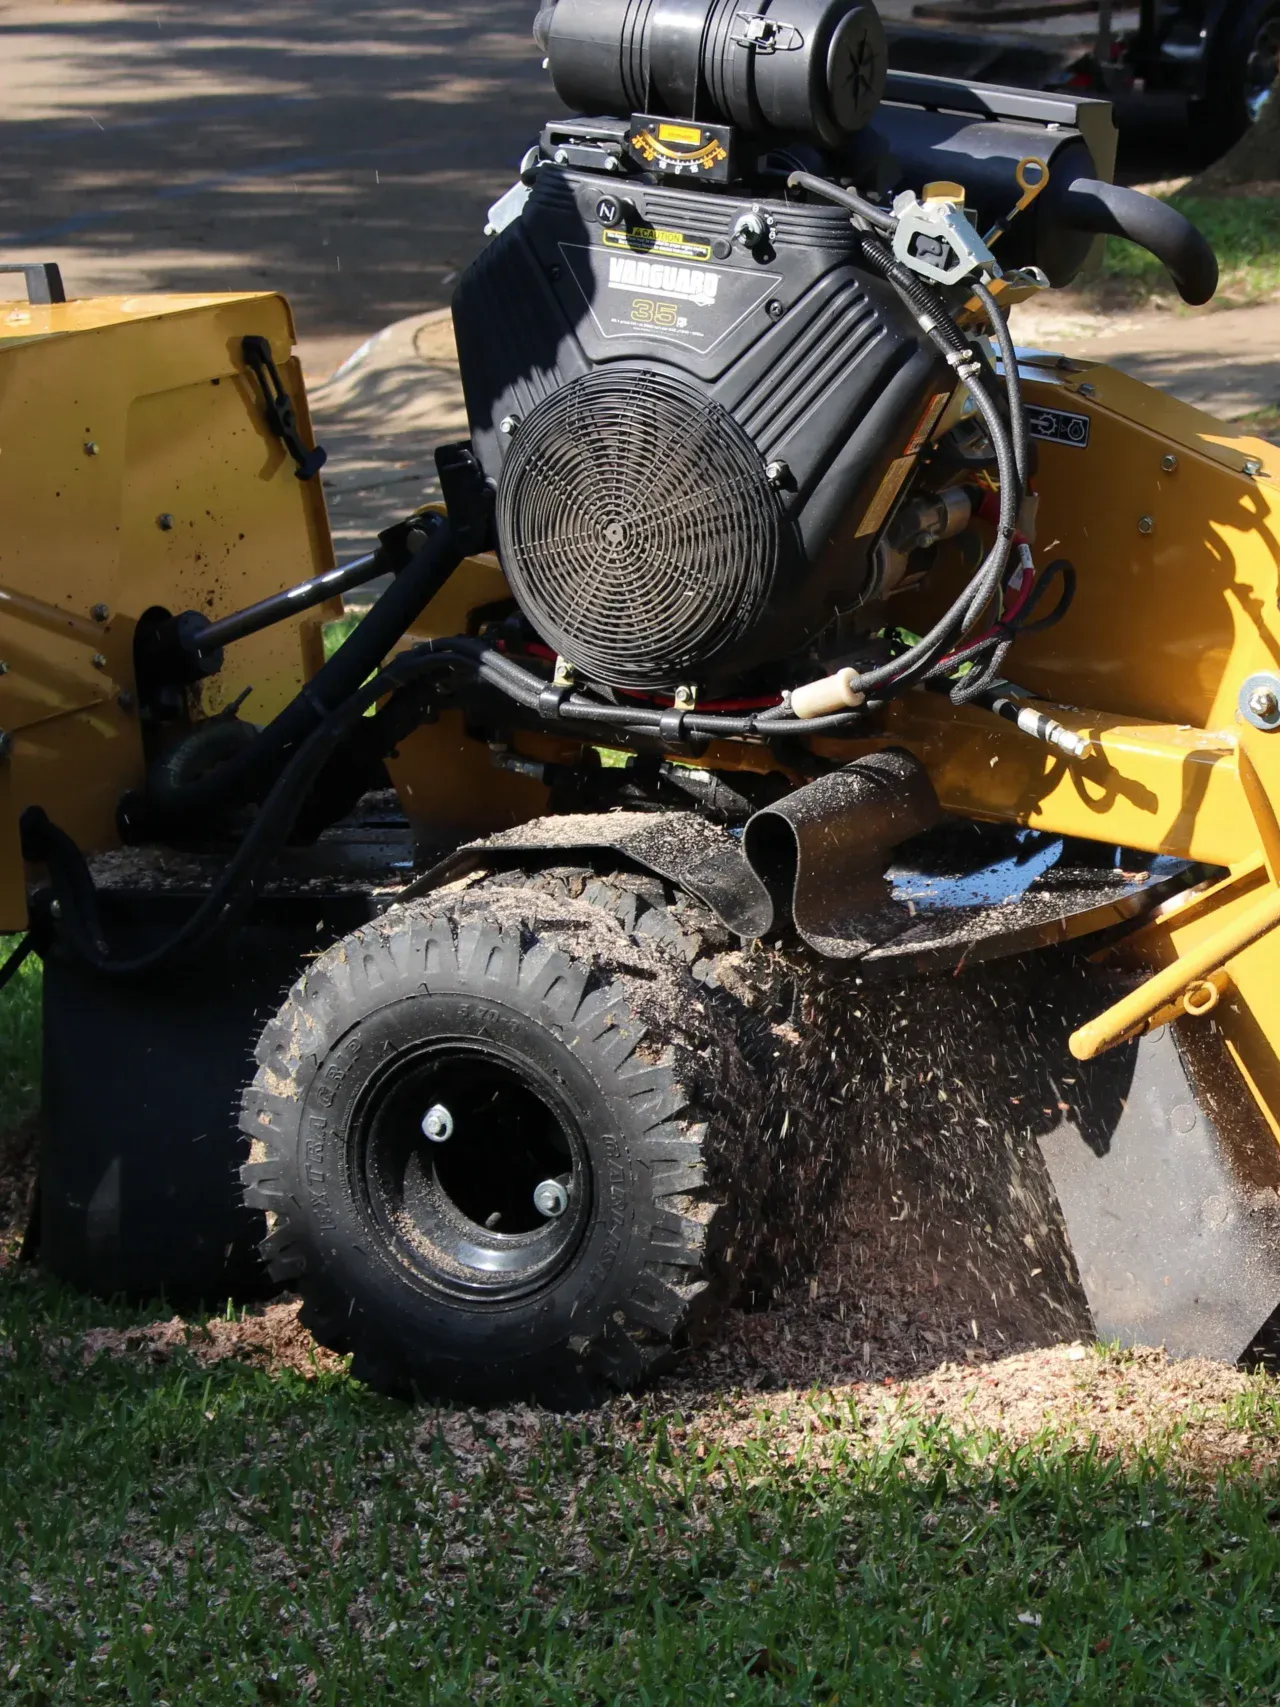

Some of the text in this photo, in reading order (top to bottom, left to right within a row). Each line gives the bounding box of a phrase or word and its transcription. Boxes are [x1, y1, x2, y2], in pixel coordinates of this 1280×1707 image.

[642, 229, 681, 242] CAUTION
[609, 257, 718, 297] VANGUARD
[631, 298, 678, 326] 35
[316, 1036, 363, 1109] GRIP
